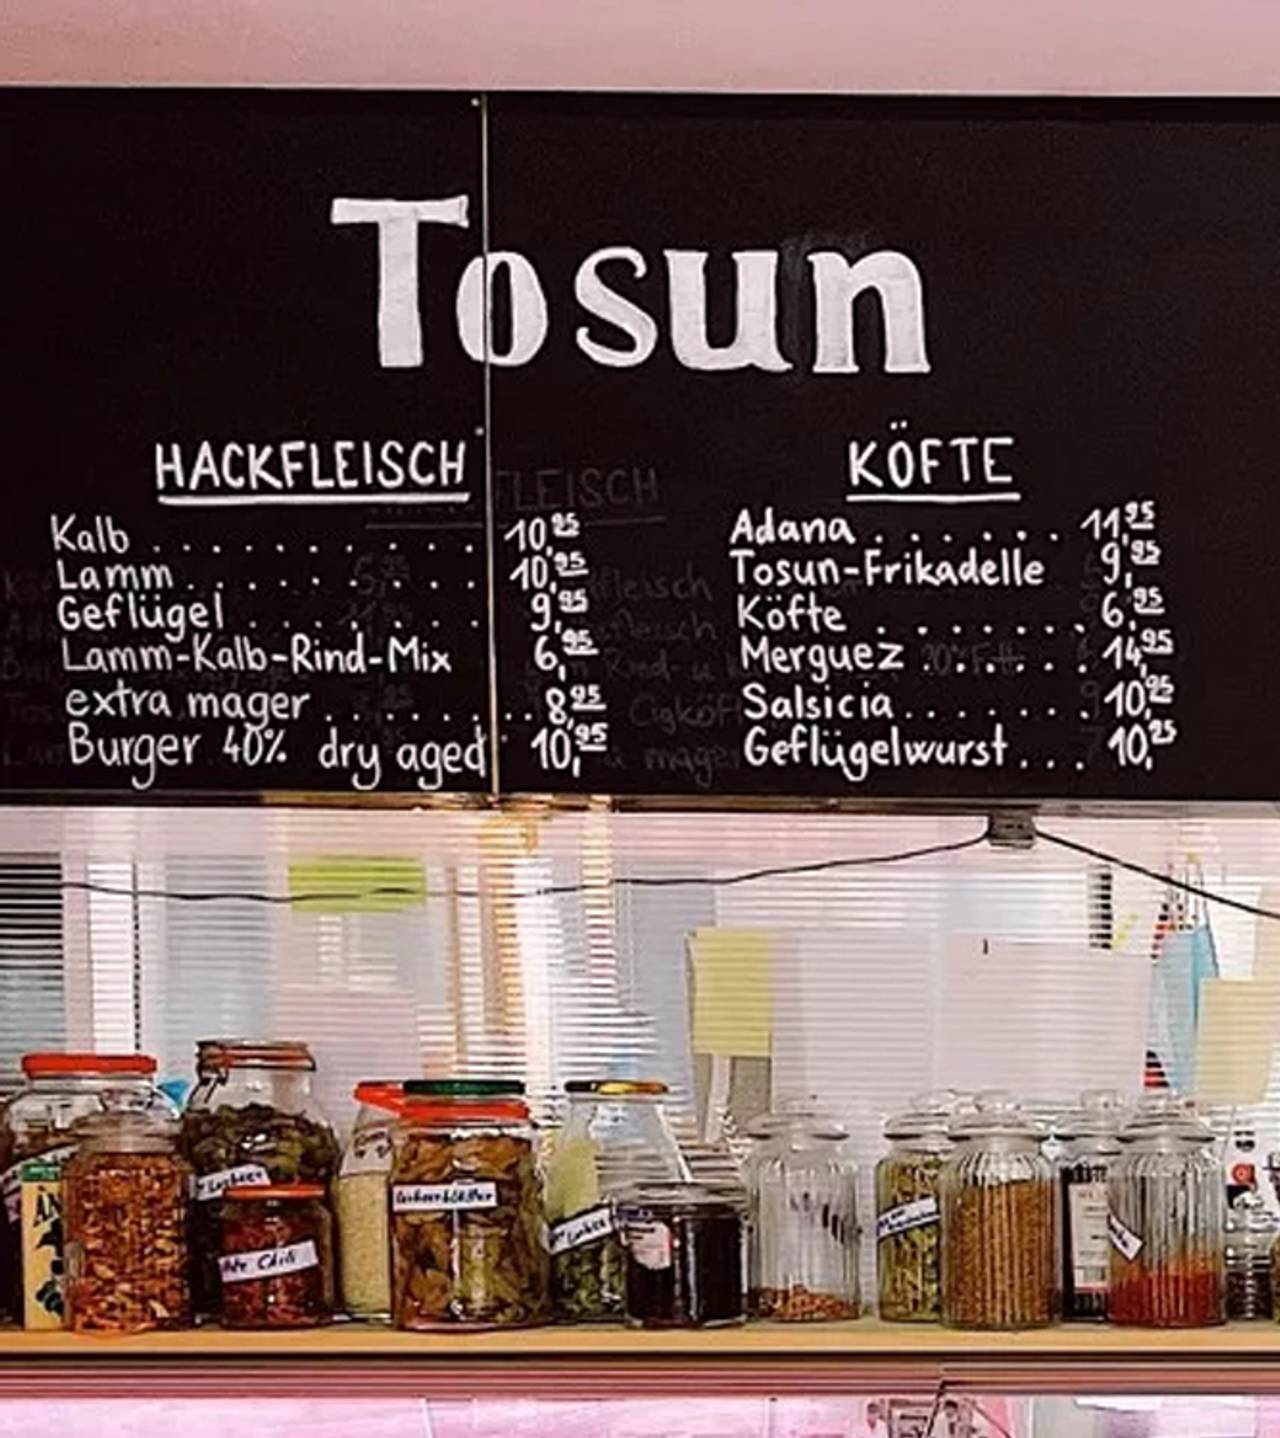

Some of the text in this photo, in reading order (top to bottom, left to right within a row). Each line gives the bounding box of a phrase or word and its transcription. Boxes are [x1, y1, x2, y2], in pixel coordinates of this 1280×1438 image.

[330, 196, 931, 374] Tosun
[155, 440, 466, 491] HACKFLEISCH
[849, 420, 1014, 489] KÖFTE
[50, 514, 129, 554] Kalb
[730, 506, 856, 545] Adana
[56, 559, 173, 590] Lamm
[729, 547, 1045, 587] Tosun-Frikadelle
[57, 591, 224, 643] Geflügel
[737, 591, 847, 633] Köfte
[62, 634, 452, 674] Lamm-Kalb-Rind-Mix
[741, 635, 904, 688] Merguez
[65, 679, 172, 717] extra
[187, 692, 310, 728] mager
[742, 682, 894, 720] Salsicia
[68, 721, 201, 790] Burger
[223, 716, 287, 766] 40%
[318, 727, 381, 791] dry
[396, 724, 486, 791] aged
[744, 723, 1008, 782] Geflügelwurst
